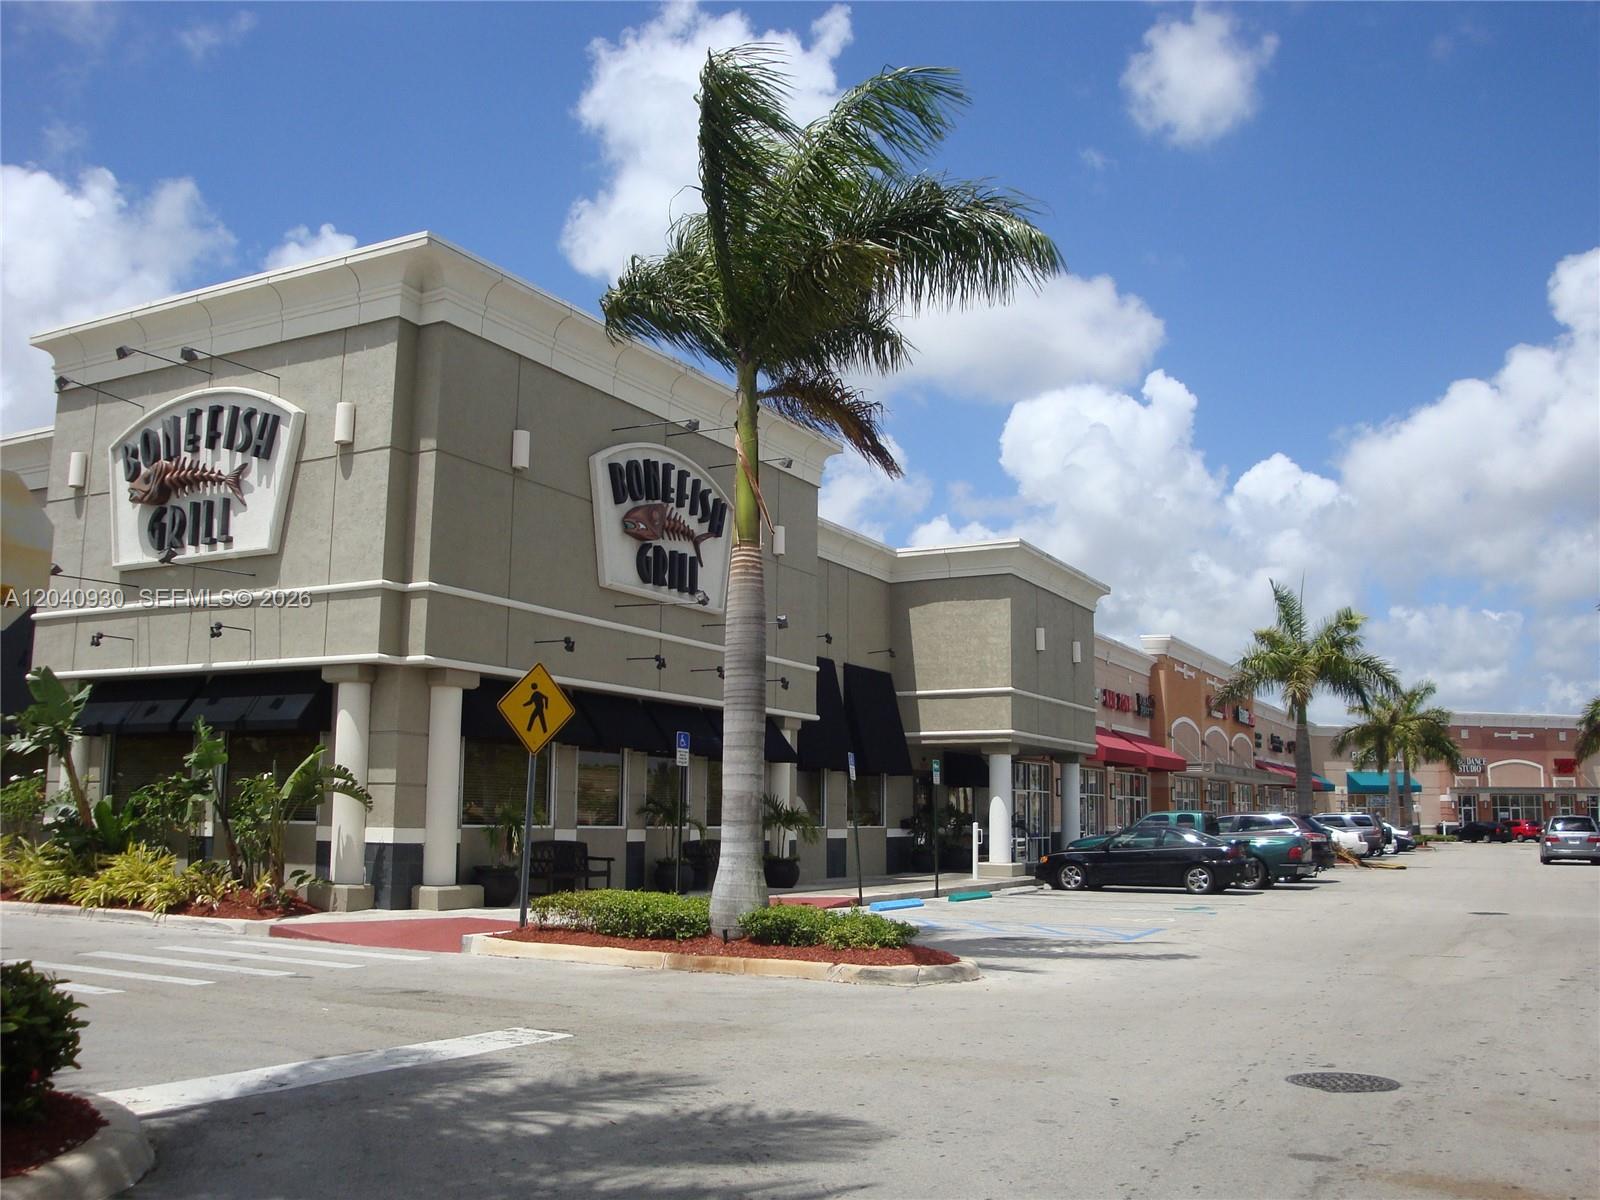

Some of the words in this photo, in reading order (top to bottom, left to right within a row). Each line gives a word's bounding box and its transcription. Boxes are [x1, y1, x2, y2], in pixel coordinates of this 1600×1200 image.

[121, 404, 280, 483] BONEFISH
[147, 497, 234, 552] GRILL
[608, 459, 728, 538] BONEFISH
[636, 543, 700, 595] GRILL
